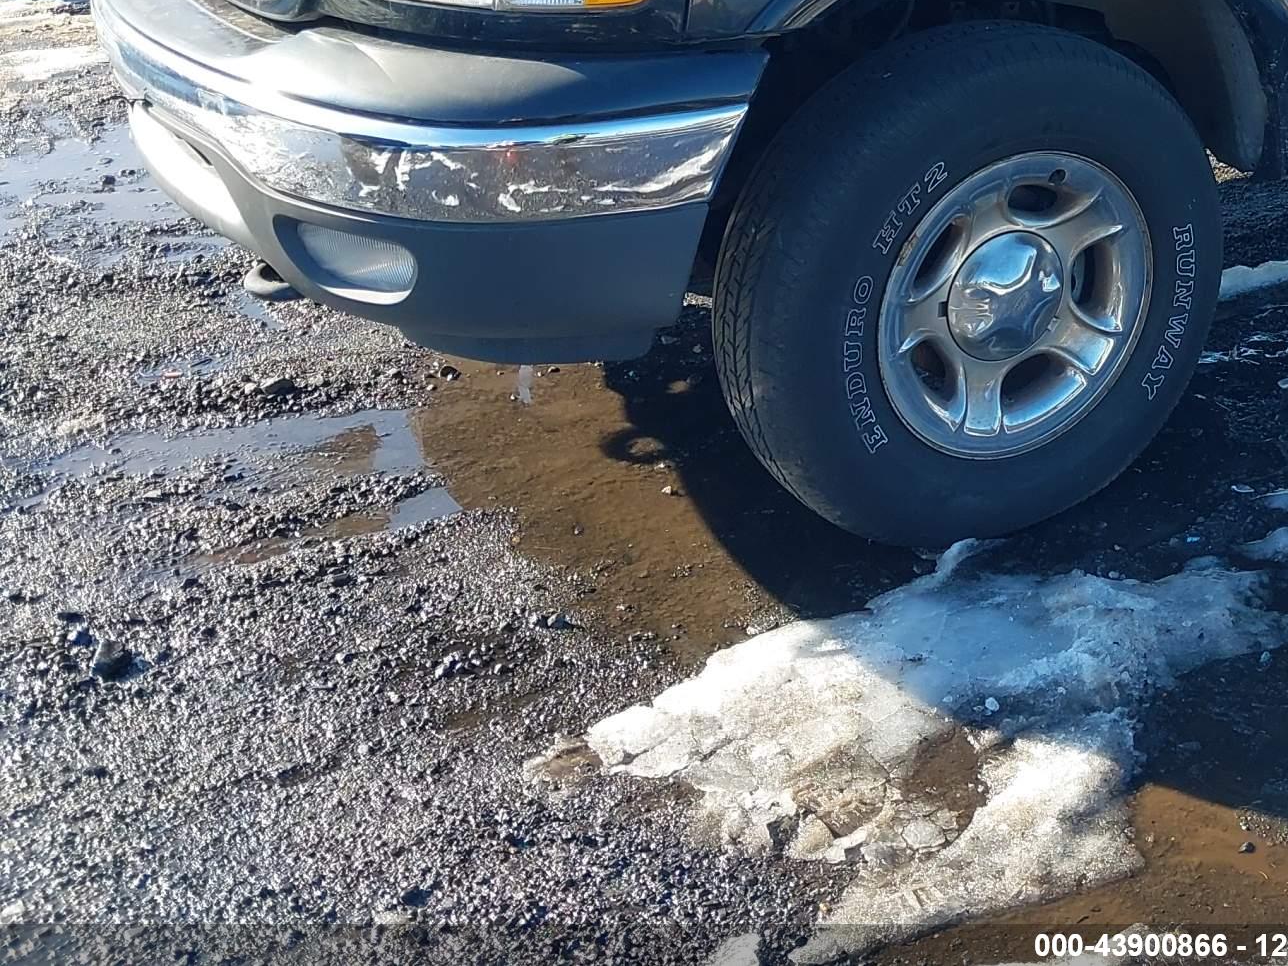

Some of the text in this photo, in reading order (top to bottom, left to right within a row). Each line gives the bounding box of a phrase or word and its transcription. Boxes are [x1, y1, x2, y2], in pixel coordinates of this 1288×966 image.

[844, 161, 948, 454] ENDURO HT2
[1141, 223, 1196, 401] RUNWAY
